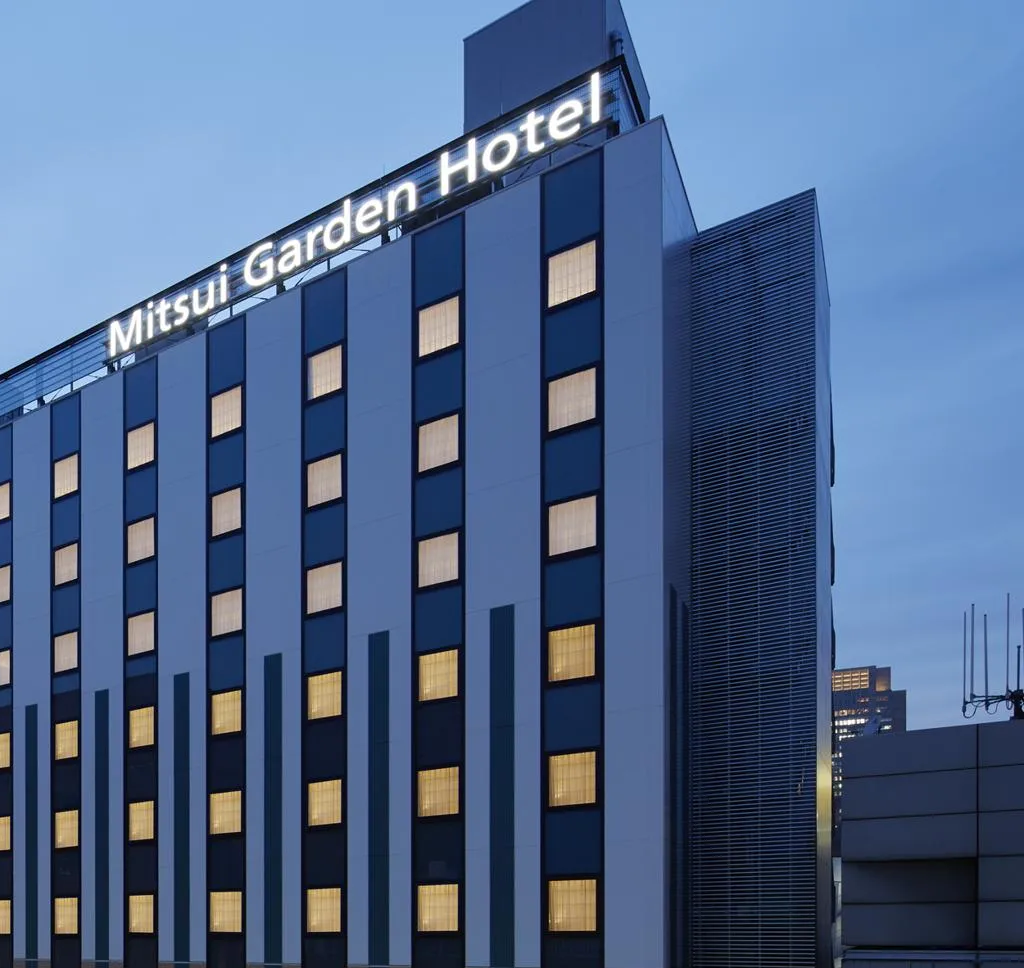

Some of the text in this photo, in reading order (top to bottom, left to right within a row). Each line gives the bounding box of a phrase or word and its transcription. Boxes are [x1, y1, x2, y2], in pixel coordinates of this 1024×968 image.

[108, 71, 602, 358] Mitsui Garden Hotel
